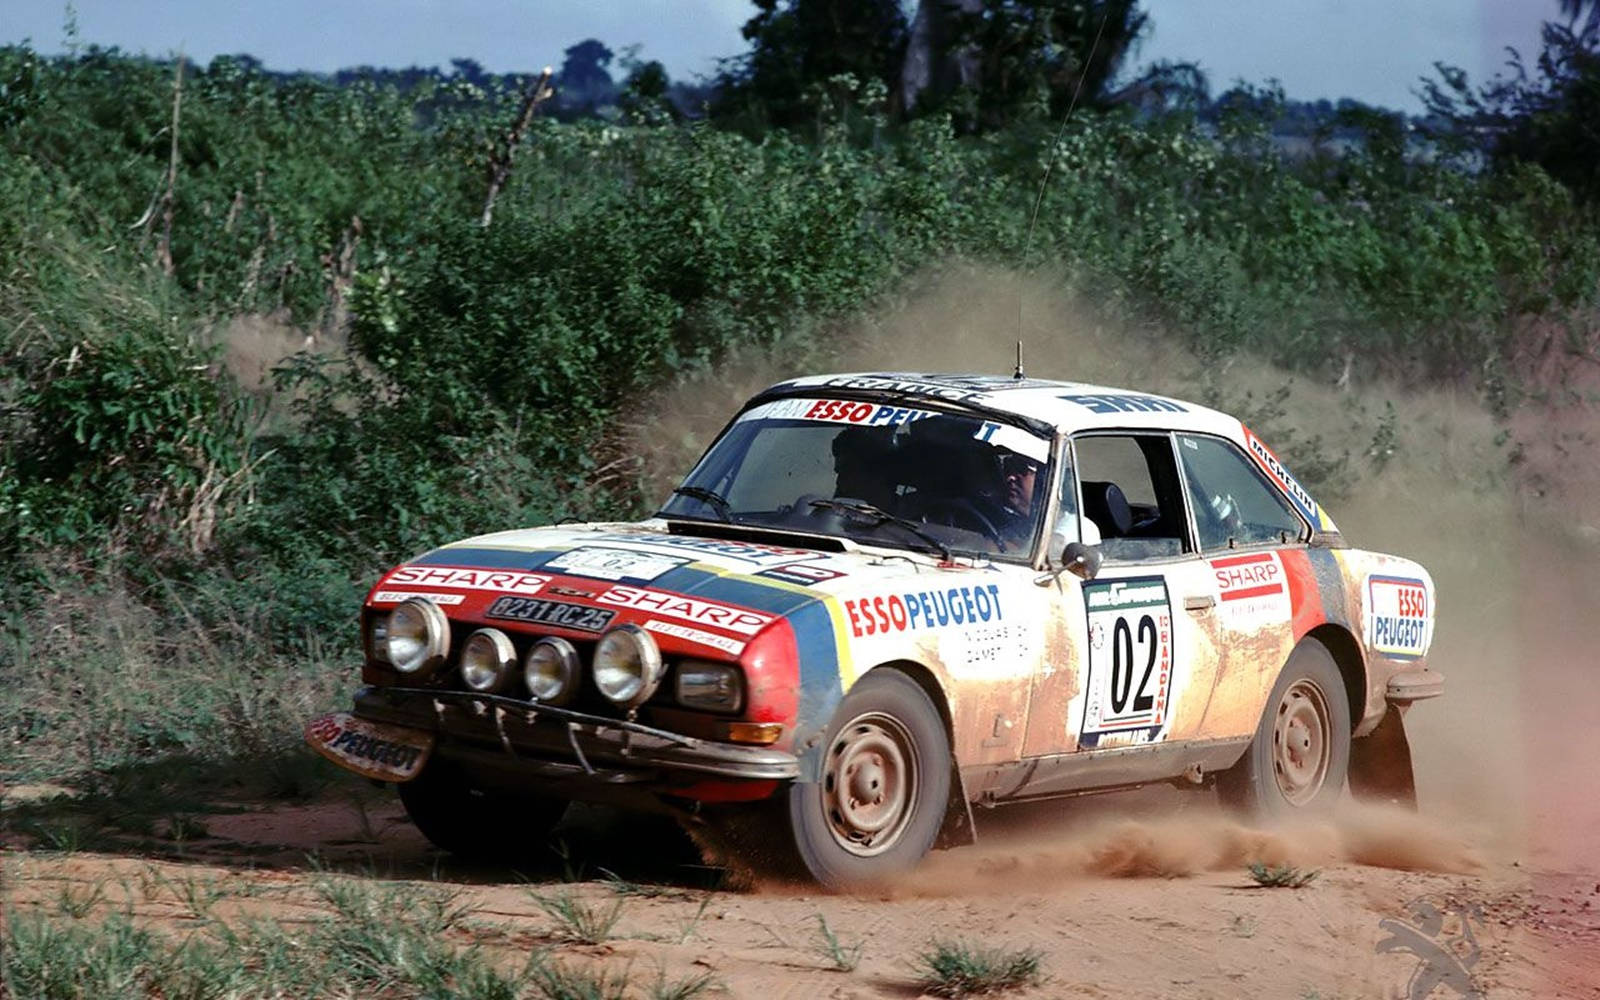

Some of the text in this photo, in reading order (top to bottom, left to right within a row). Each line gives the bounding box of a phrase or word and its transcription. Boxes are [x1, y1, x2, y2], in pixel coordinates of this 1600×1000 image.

[804, 401, 873, 423] ESSO
[1252, 440, 1313, 511] MICHELIN
[392, 568, 548, 590] SHARP
[1215, 563, 1279, 589] SHARP
[603, 587, 765, 627] SHARP
[1398, 588, 1425, 618] ESSO
[1375, 616, 1424, 649] PEUGEOT
[1110, 614, 1158, 714] 02
